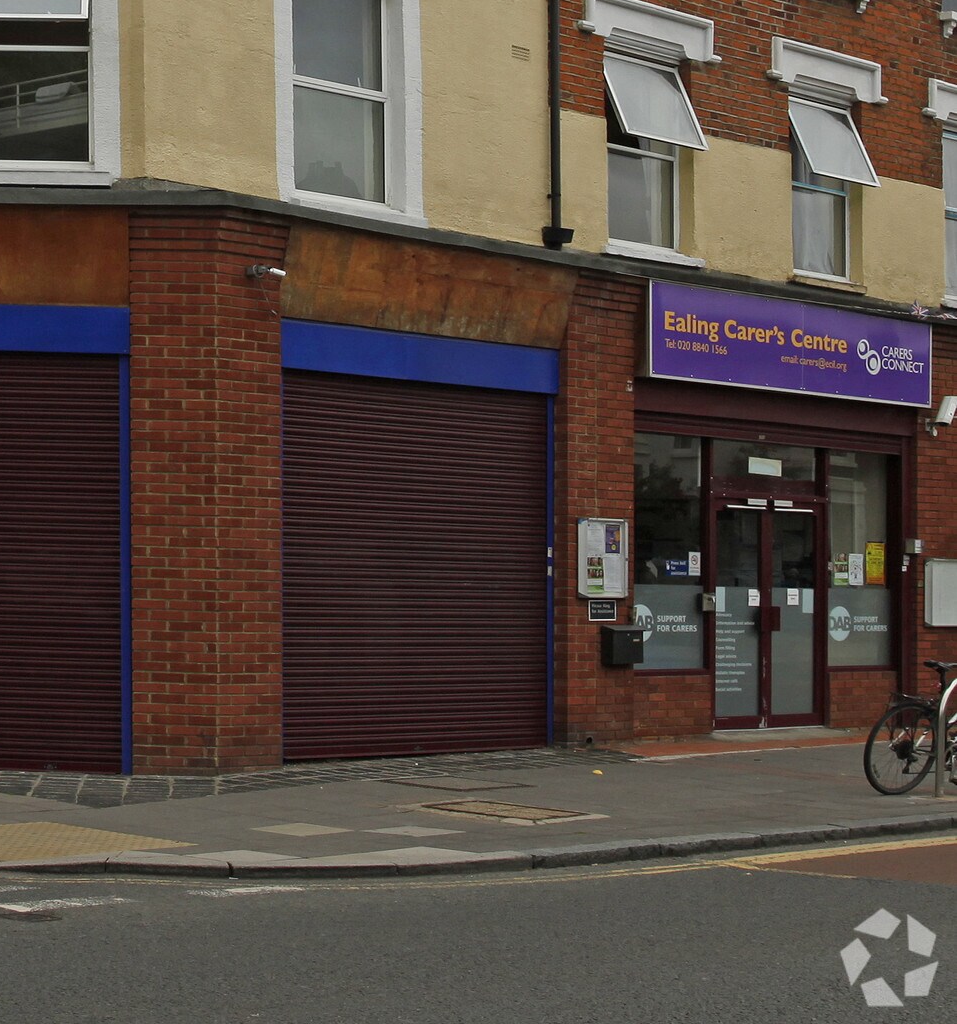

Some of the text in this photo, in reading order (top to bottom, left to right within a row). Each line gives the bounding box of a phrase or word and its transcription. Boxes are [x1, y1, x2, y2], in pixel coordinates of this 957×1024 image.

[664, 310, 848, 354] Ealing Carer's Centre
[664, 338, 728, 355] Tel: 020 8840 1566
[881, 345, 913, 361] CARERS
[881, 358, 924, 374] CONNECT
[656, 615, 687, 623] SUPPORT
[853, 615, 879, 624] SUPPORT
[656, 624, 698, 632] FOR CARERS
[853, 624, 888, 632] FOR CARERS
